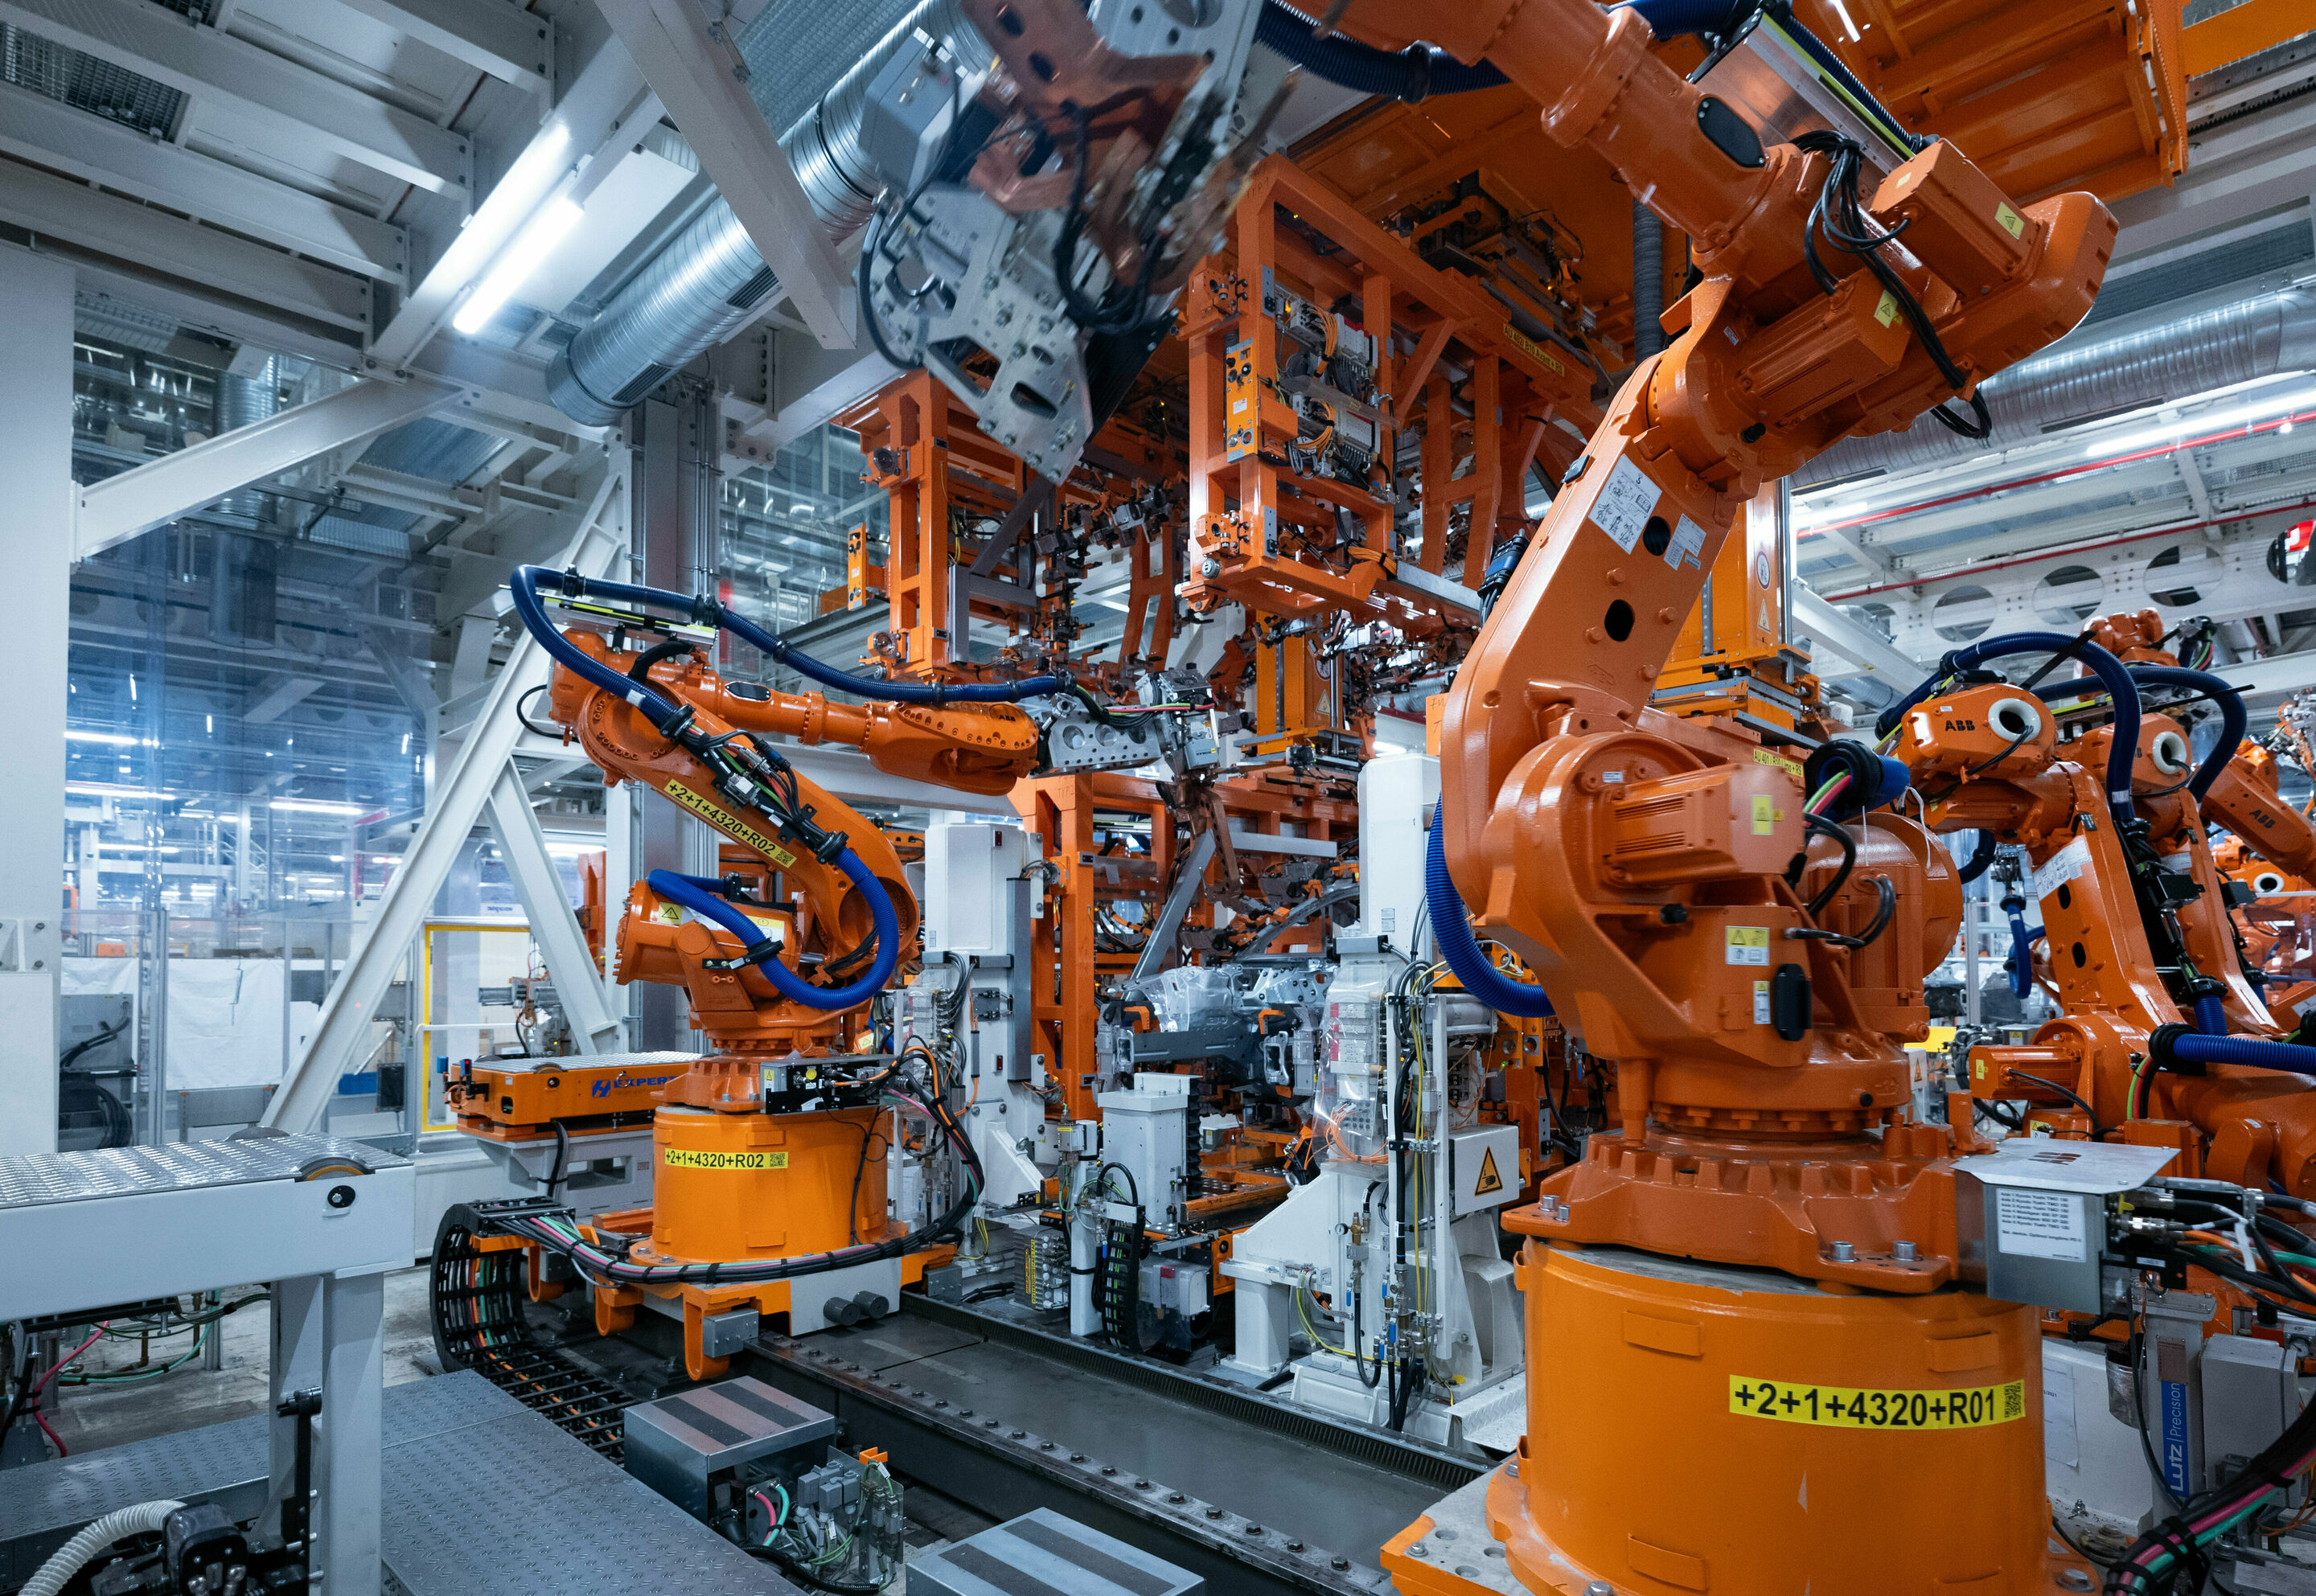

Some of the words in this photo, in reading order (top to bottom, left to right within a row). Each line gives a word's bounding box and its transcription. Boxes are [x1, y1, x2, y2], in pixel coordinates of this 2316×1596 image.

[1945, 720, 1975, 731] ABB
[1755, 750, 1761, 762] AU
[669, 783, 776, 855] +2+1+4320+R02
[2249, 809, 2275, 829] ABB
[666, 1150, 764, 1168] +2+1+4320+R02
[1735, 1383, 1994, 1426] +2+1+4320+R01
[2170, 1383, 2182, 1437] Precision
[2169, 1444, 2184, 1492] Lutz
